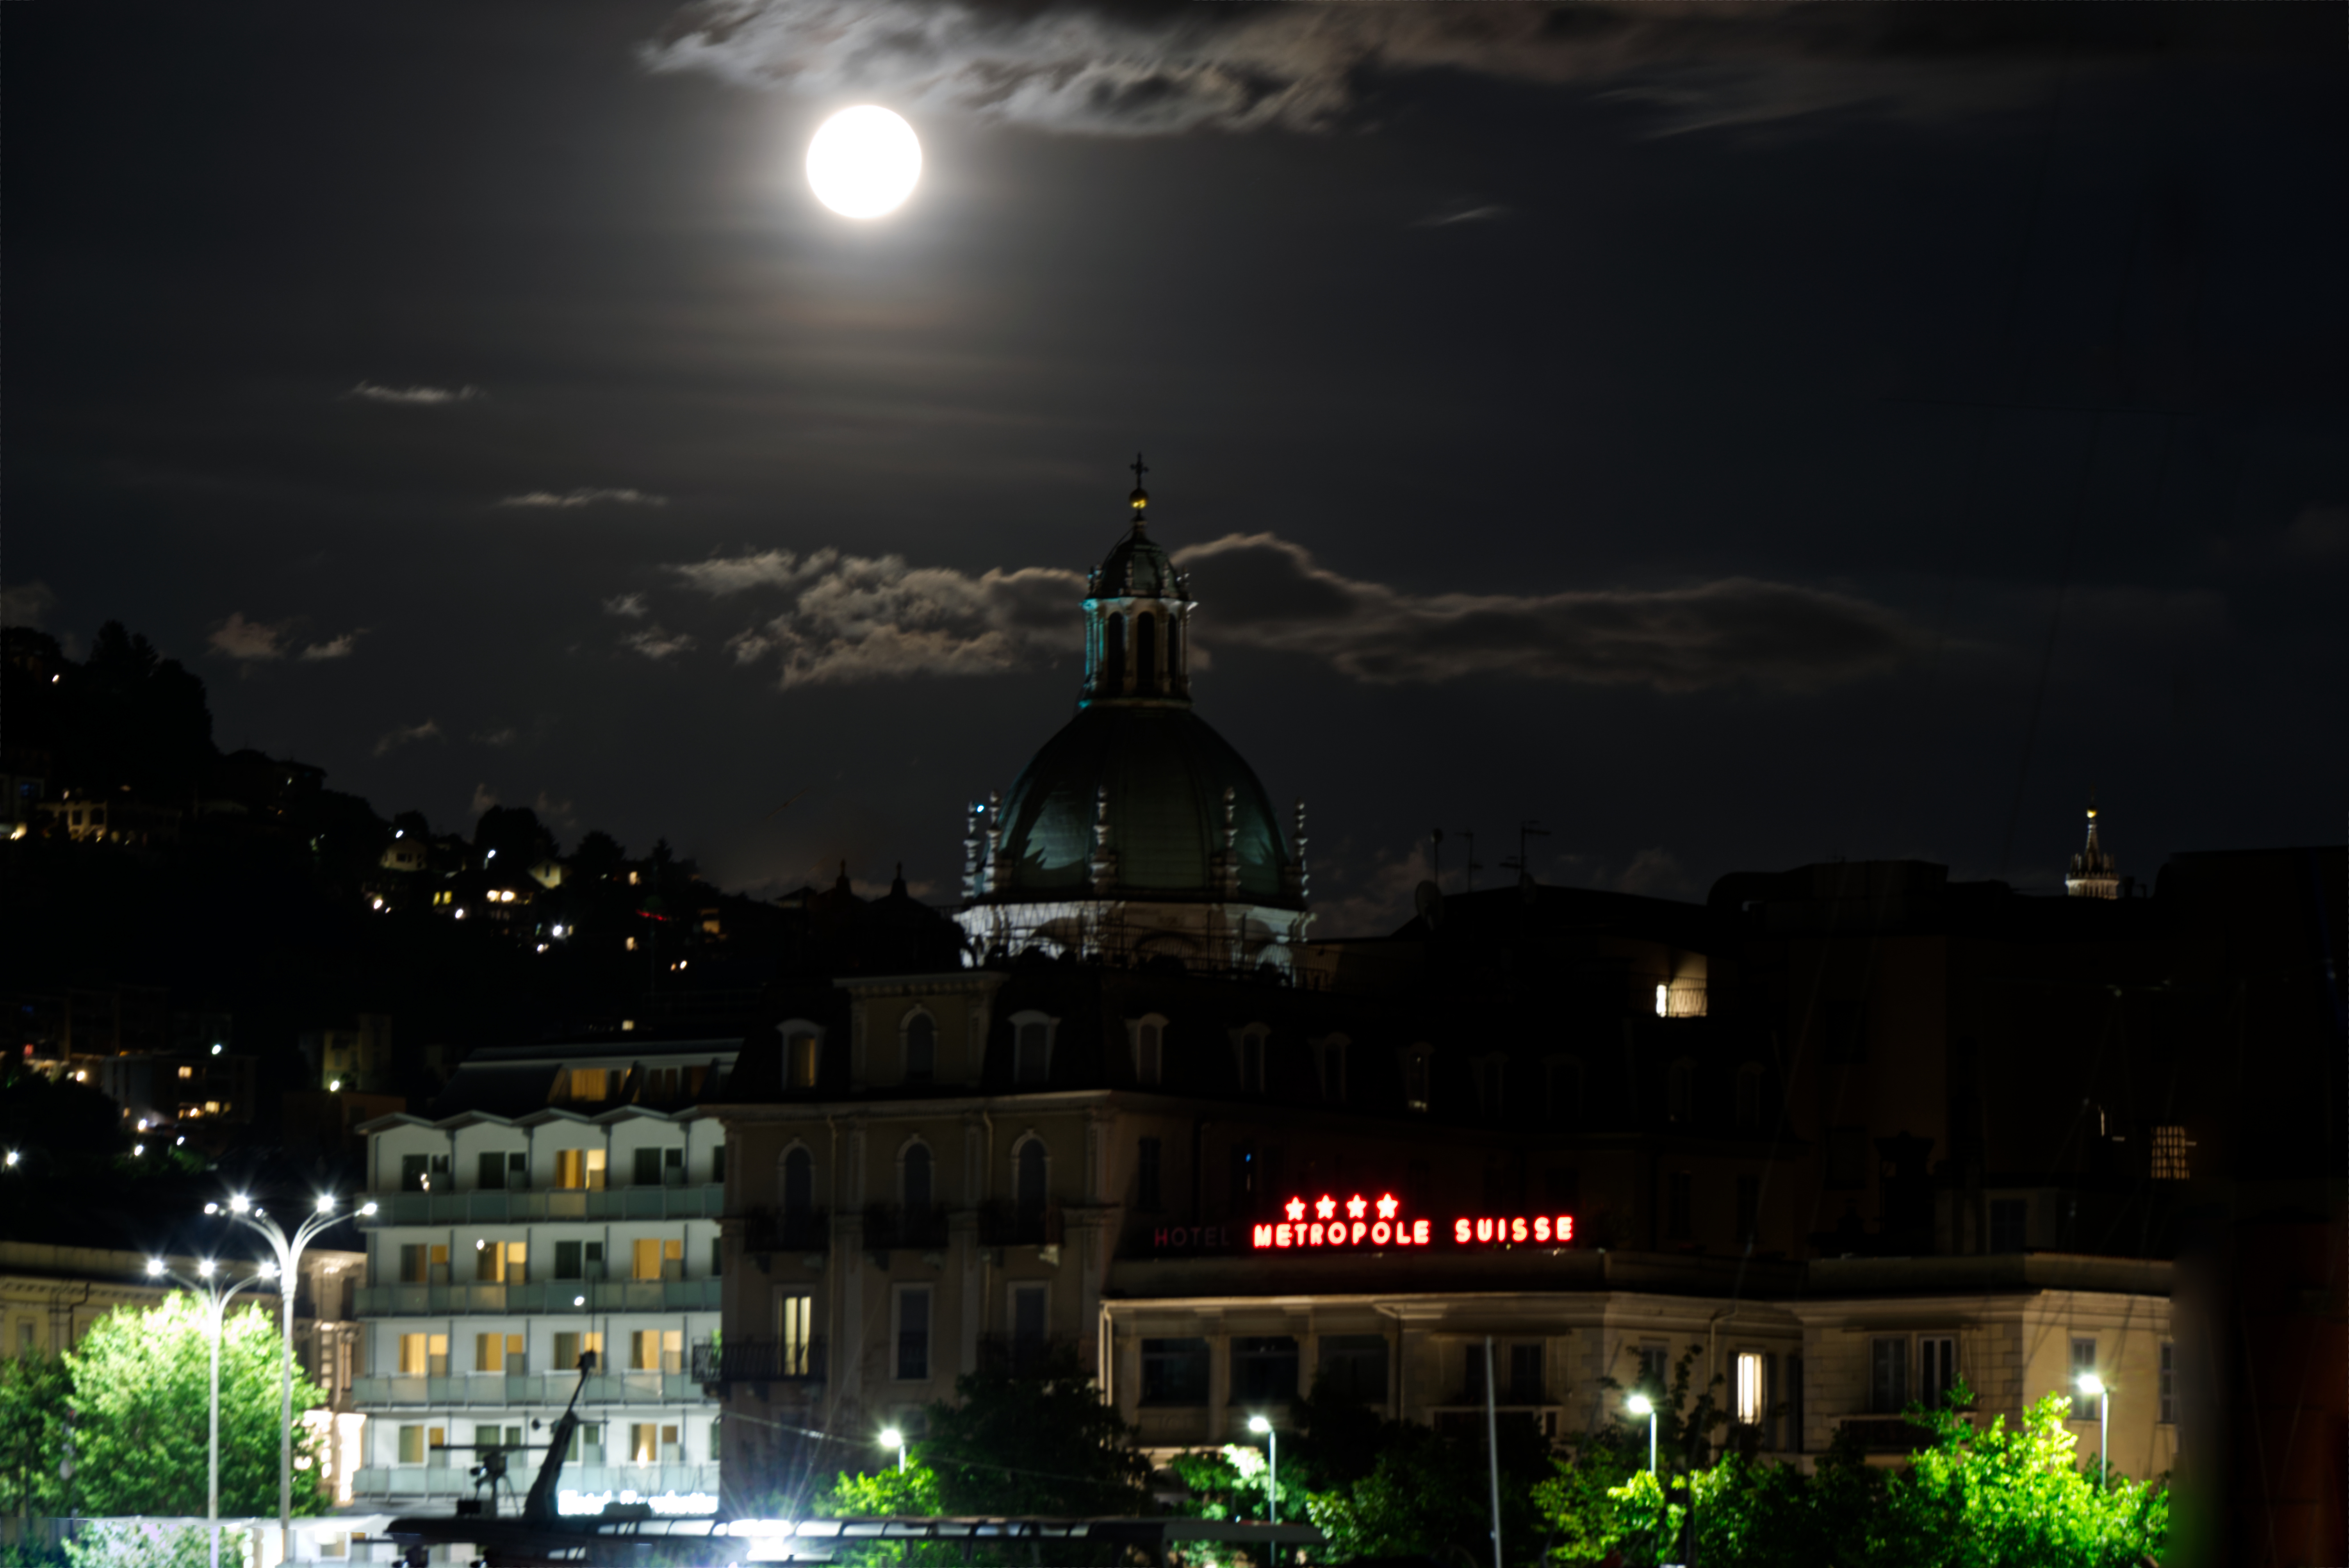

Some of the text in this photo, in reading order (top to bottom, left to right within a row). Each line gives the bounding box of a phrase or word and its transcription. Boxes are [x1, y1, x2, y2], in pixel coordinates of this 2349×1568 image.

[1153, 1215, 1573, 1248] HOTEL METROPOLE SUISSE
